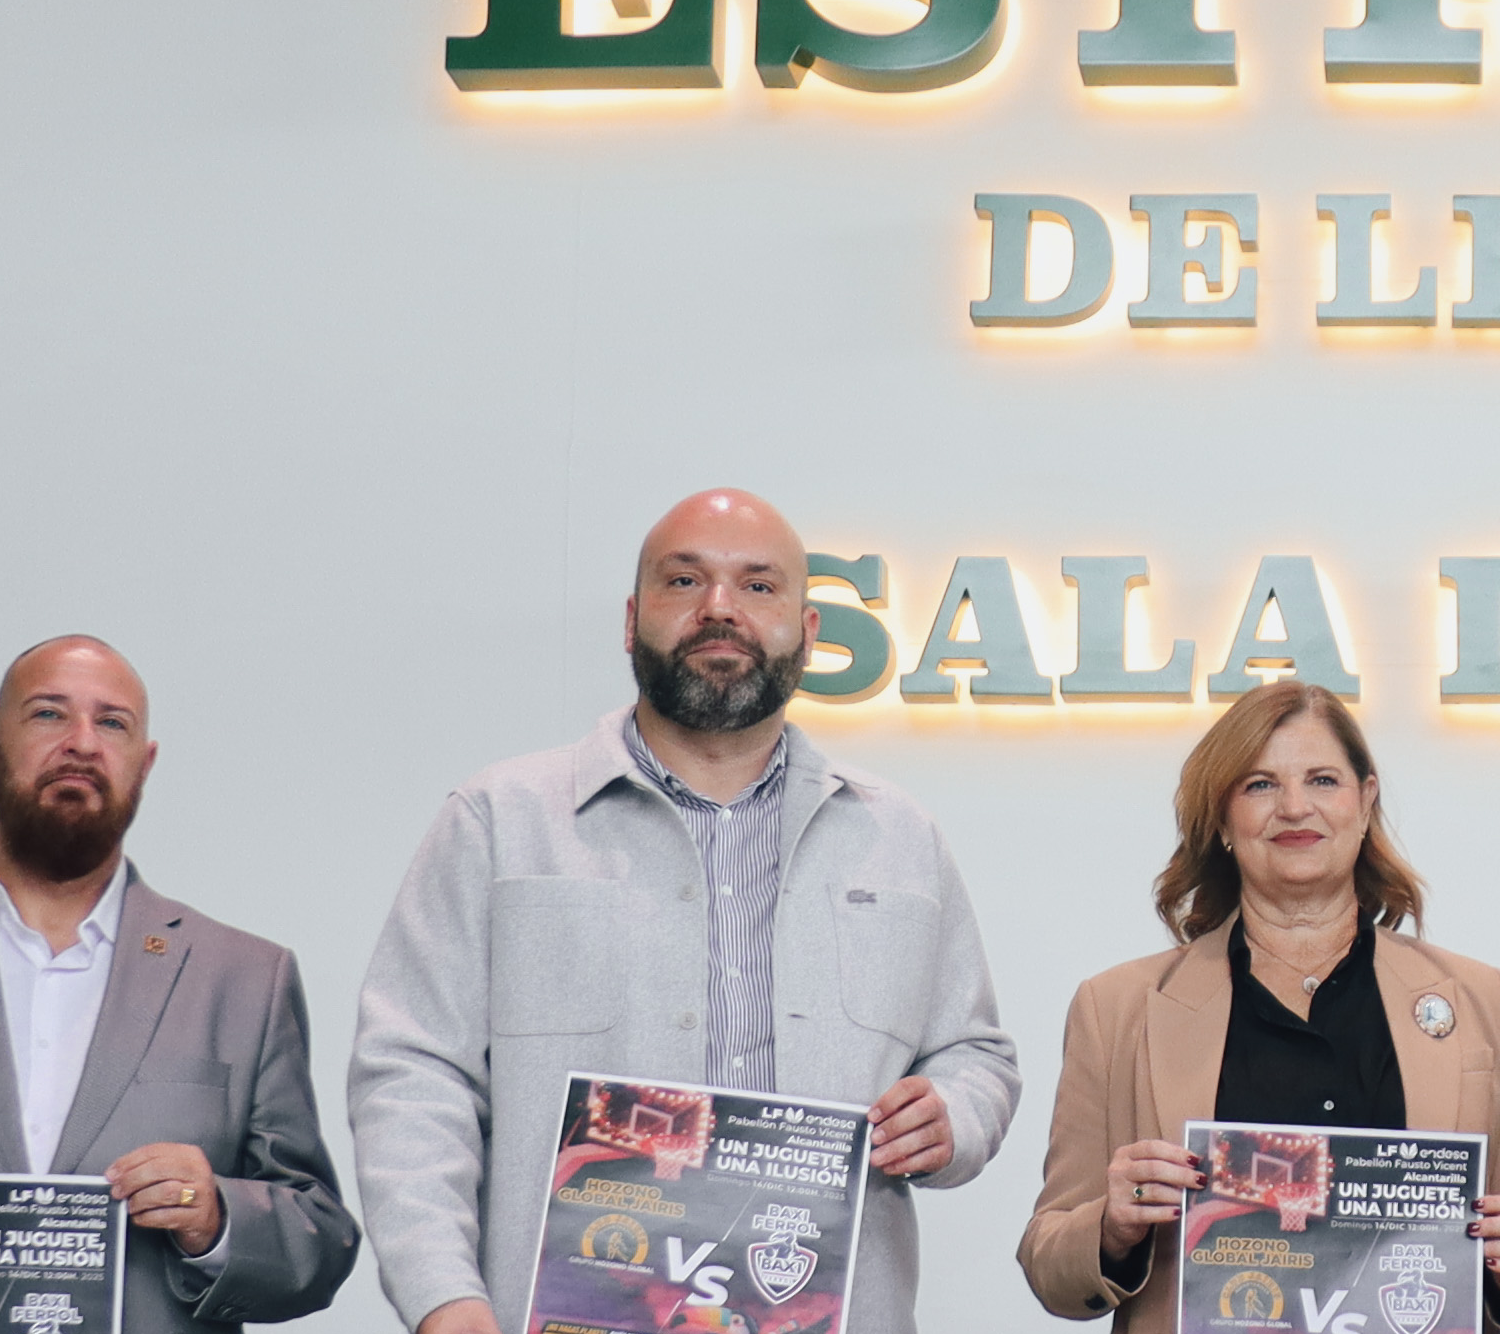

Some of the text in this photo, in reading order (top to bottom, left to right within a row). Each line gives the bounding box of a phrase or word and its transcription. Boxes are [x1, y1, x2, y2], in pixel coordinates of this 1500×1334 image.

[969, 192, 1260, 329] DE
[794, 553, 1361, 706] SALA
[727, 1114, 855, 1141] Pabellón Fausto Vicent
[761, 1106, 857, 1130] LF endesa
[785, 1134, 853, 1153] Alcantarilla
[1376, 1144, 1469, 1160] LF endesa
[717, 1138, 851, 1172] UN JUGUETE,
[1345, 1156, 1467, 1171] Pabellón Fausto Vicent
[715, 1155, 848, 1187] UNA ILUSIÓN
[1402, 1171, 1466, 1184] Alcantarilla
[11, 1188, 33, 1201] LF
[586, 1178, 661, 1200] HOZONO
[1338, 1182, 1466, 1204] UN JUGUETE,
[559, 1187, 685, 1218] GLOBAL JAIRIS
[768, 1203, 811, 1221] BAXI
[1338, 1199, 1464, 1220] UNA ILUSIÓN
[753, 1214, 823, 1236] FERROL
[1216, 1237, 1289, 1252] HOZONO
[1393, 1244, 1433, 1258] BAXI
[20, 1247, 103, 1267] ILUSIÓN
[762, 1256, 805, 1274] BAXI
[1192, 1249, 1313, 1268] GLOBAL JAIRIS
[1381, 1256, 1445, 1271] FERROL
[666, 1236, 734, 1309] VS
[25, 1294, 68, 1308] BAXI
[1393, 1297, 1432, 1311] BAXI
[12, 1307, 81, 1322] FERROL
